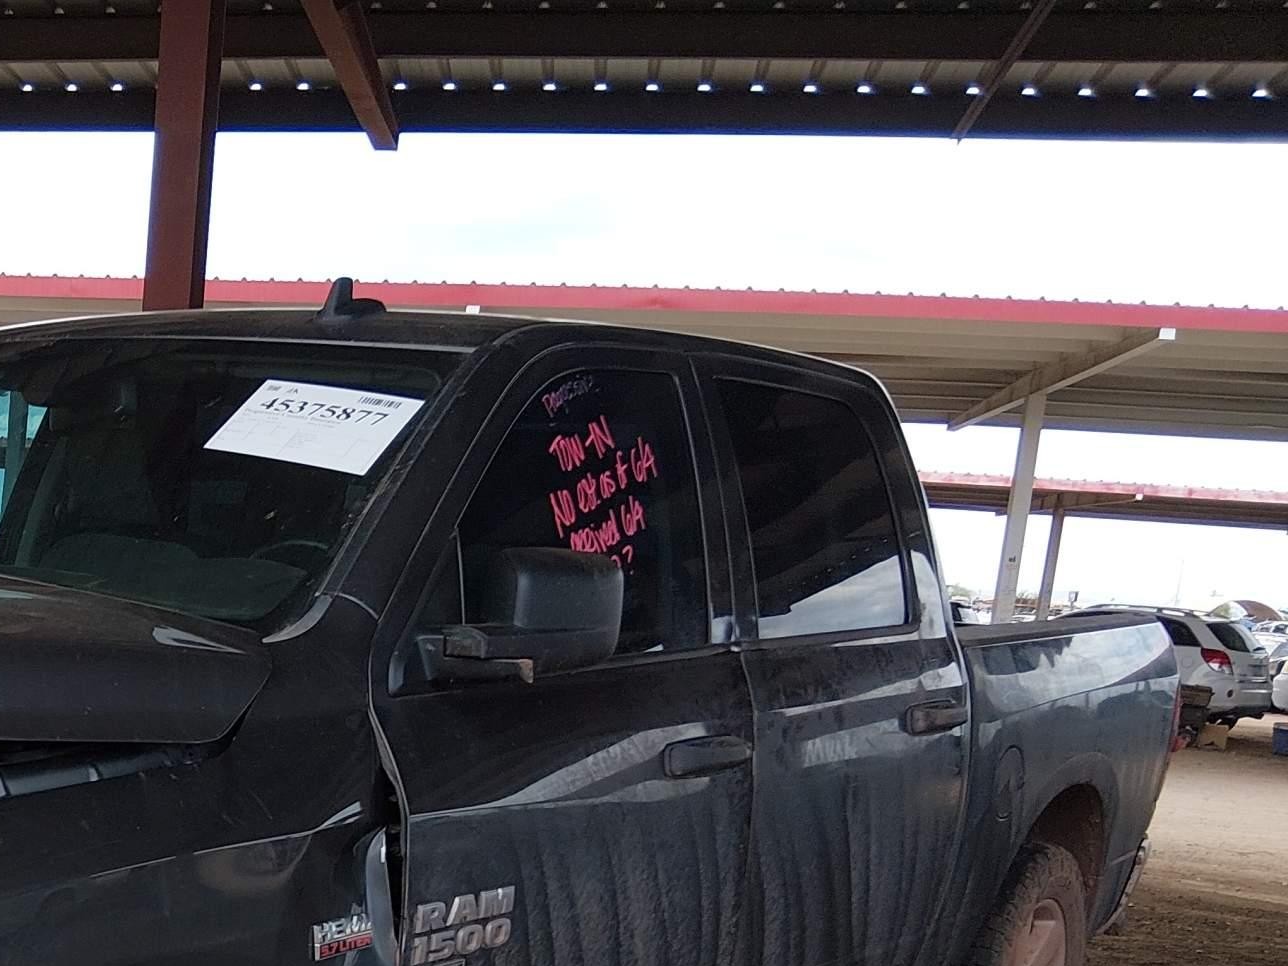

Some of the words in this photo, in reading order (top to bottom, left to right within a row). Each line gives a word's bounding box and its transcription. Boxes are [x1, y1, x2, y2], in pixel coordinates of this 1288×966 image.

[260, 397, 389, 426] 45375877
[416, 886, 515, 935] RAM
[411, 918, 511, 966] 1500
